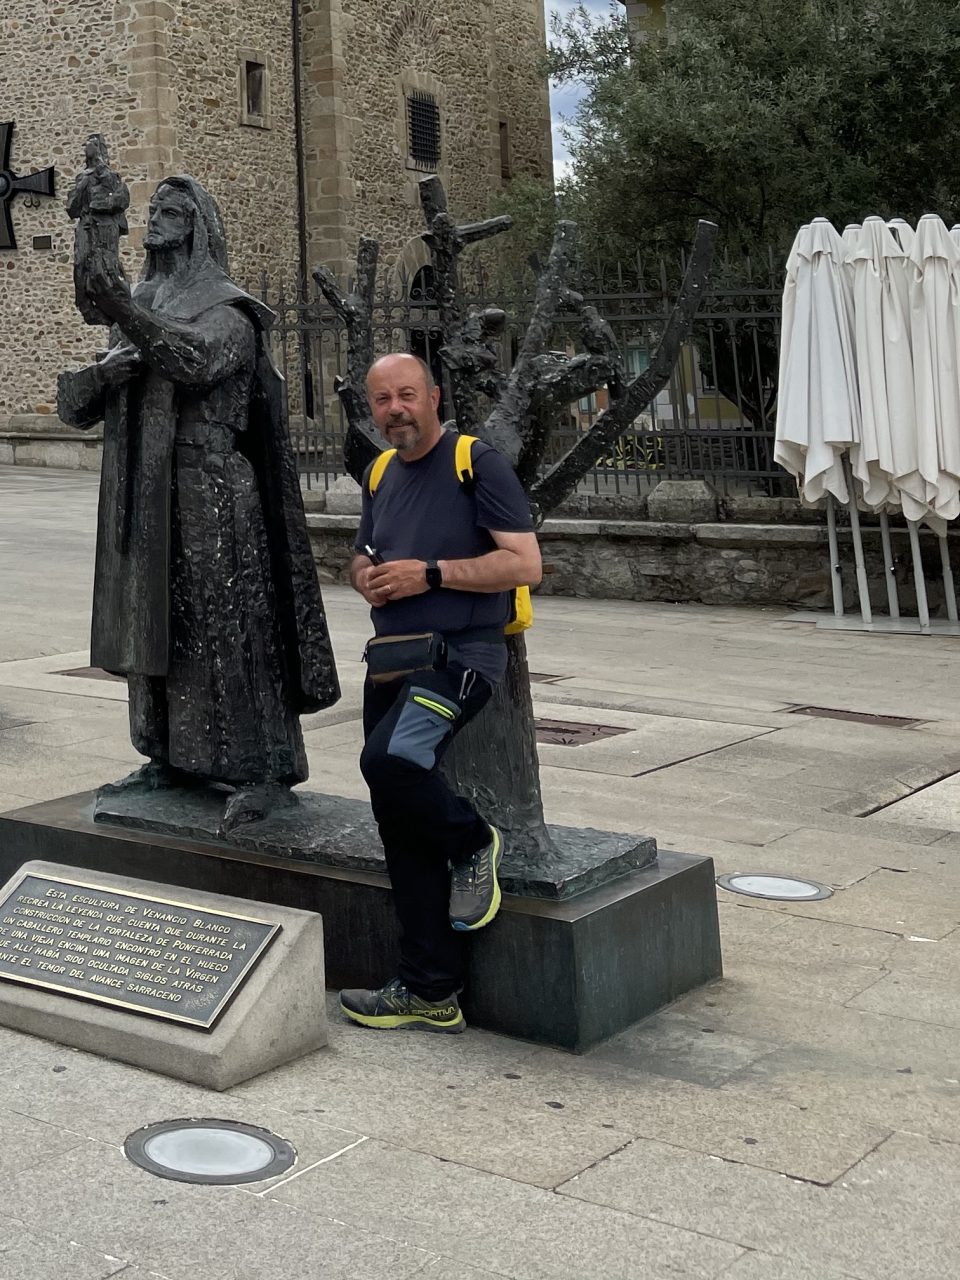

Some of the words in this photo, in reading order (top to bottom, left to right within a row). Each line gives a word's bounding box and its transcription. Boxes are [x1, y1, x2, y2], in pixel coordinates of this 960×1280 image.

[17, 896, 48, 907] RECREA
[66, 906, 103, 918] LEYENDA
[106, 914, 124, 923] QUE
[128, 919, 161, 931] CUENTA
[165, 927, 183, 936] QUE
[186, 932, 229, 947] DURANTE
[233, 942, 246, 951] LA
[46, 889, 66, 899] ESTA
[72, 895, 120, 910] ESCULTURA
[125, 906, 138, 914] DE
[143, 908, 187, 924] VENANCIO
[193, 920, 230, 934] BLANCO
[11, 930, 27, 939] UNA
[31, 934, 55, 946] VIEJA
[58, 941, 88, 953] ENCINA
[93, 950, 110, 958] UNA
[115, 954, 149, 967] IMAGEN
[151, 963, 165, 971] DE
[168, 966, 181, 975] LA
[186, 969, 219, 983] VIRGEN
[17, 920, 63, 935] CABALLERO
[67, 931, 112, 946] TEMPLARIO
[164, 953, 178, 961] EN
[181, 956, 191, 965] EL
[198, 960, 229, 972] HUECO
[73, 919, 86, 928] DE
[89, 923, 100, 931] LA
[104, 927, 152, 942] FORTALEZA
[156, 938, 169, 947] DE
[173, 940, 233, 960] PONFERRADA
[13, 943, 36, 952] ALLÍ
[35, 948, 60, 959] HABÍA
[64, 954, 84, 964] SIDO
[88, 960, 129, 976] OCULTADA
[135, 971, 168, 985] SIGLOS
[21, 958, 31, 966] EL
[37, 961, 66, 974] TEMOR
[69, 969, 85, 979] DEL
[90, 975, 124, 988] AVANCE
[127, 983, 181, 1002] SARRACENO
